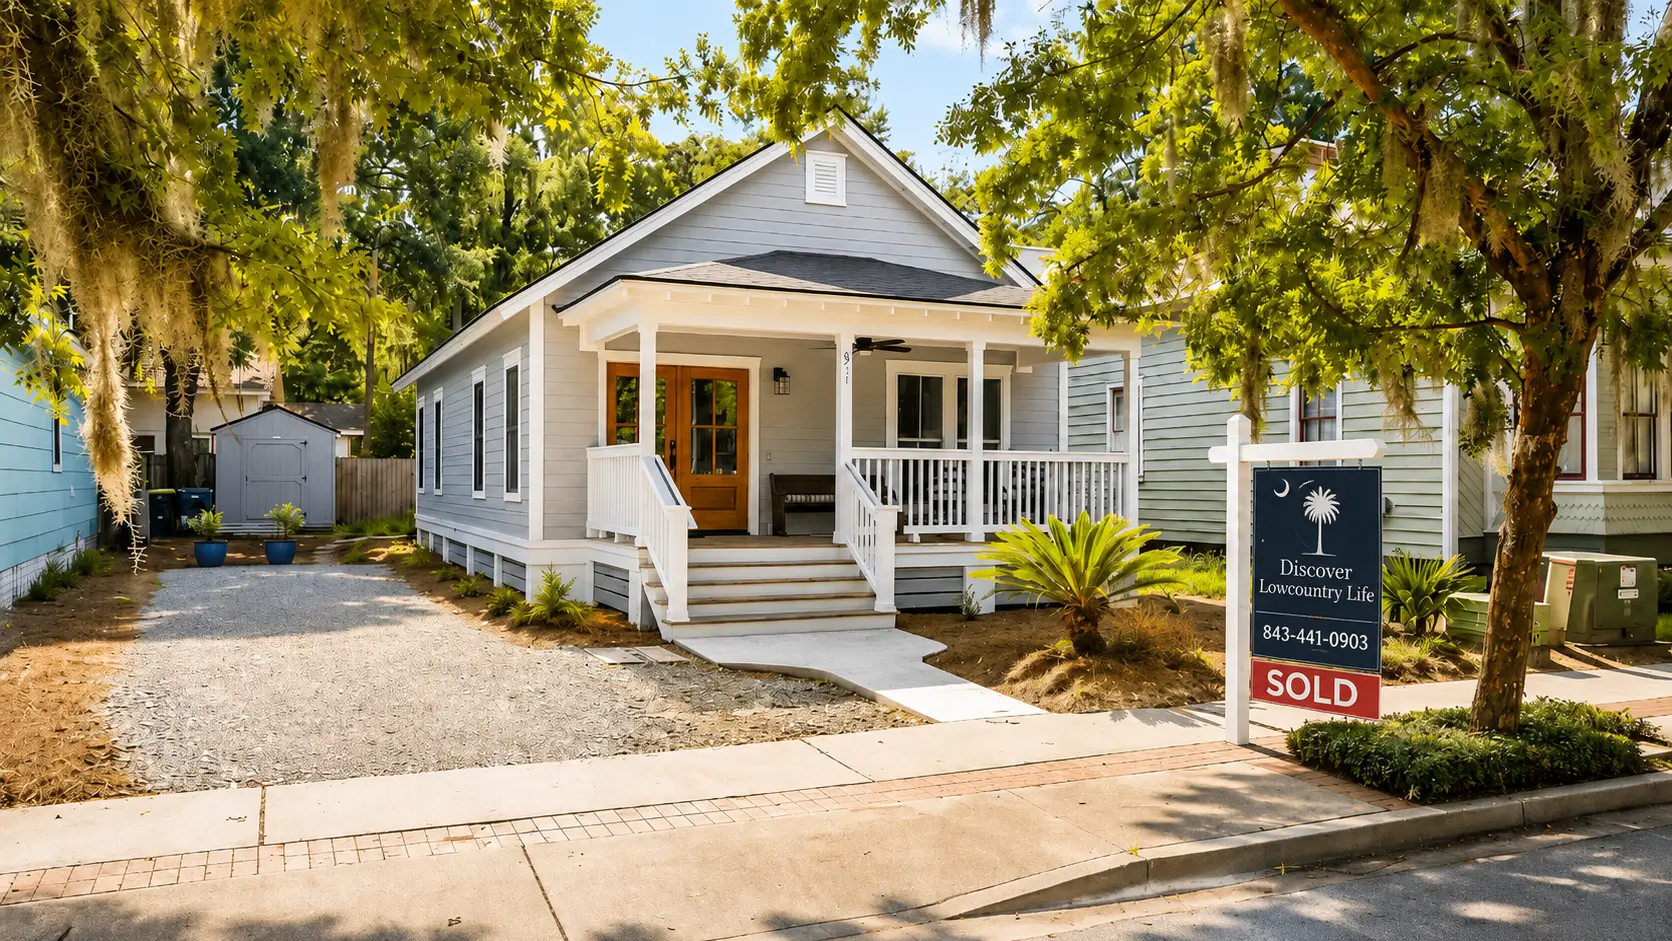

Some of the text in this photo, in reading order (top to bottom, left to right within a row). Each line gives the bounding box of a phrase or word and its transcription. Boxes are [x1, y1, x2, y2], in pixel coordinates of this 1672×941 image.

[1280, 558, 1353, 580] Discover
[1259, 578, 1375, 603] Lowcountry Life
[1262, 624, 1369, 651] 843-441-0903
[1266, 669, 1358, 708] SOLD
